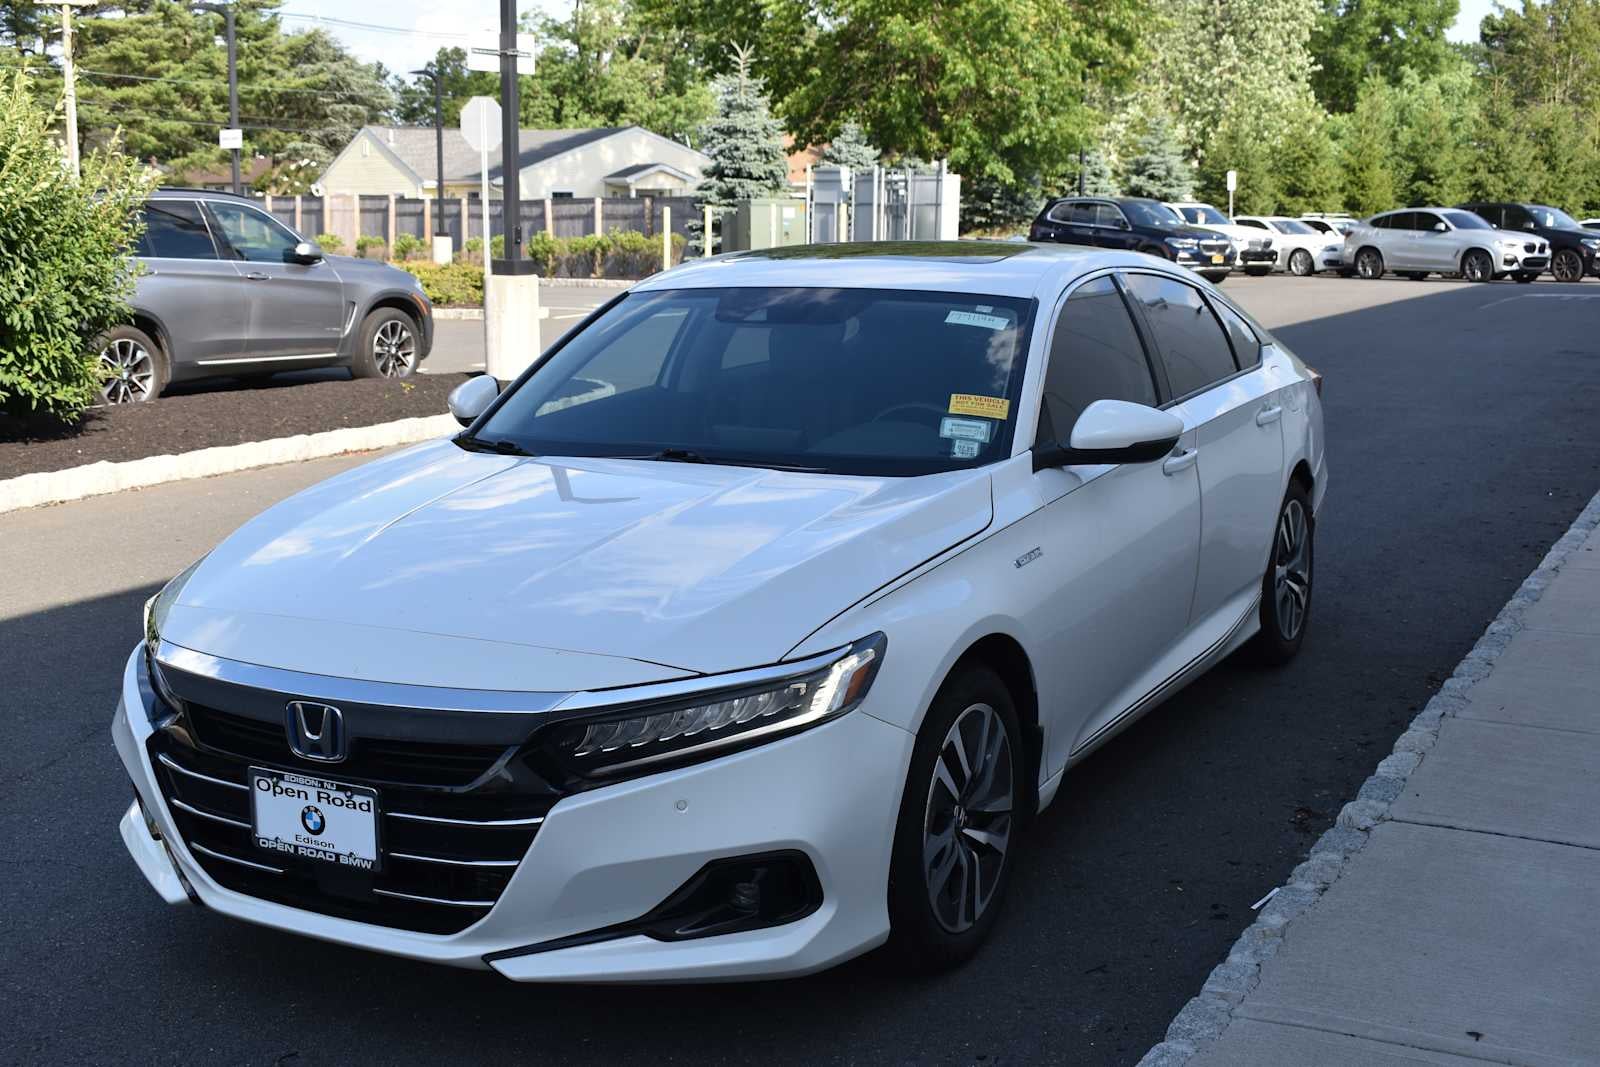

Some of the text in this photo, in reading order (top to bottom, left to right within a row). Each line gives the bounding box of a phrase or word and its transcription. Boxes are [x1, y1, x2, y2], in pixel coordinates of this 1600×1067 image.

[256, 778, 309, 801] Open
[316, 790, 371, 813] Road
[323, 782, 337, 791] NJ
[295, 834, 335, 849] Edison
[259, 838, 373, 869] OPEN ROAD BMW
